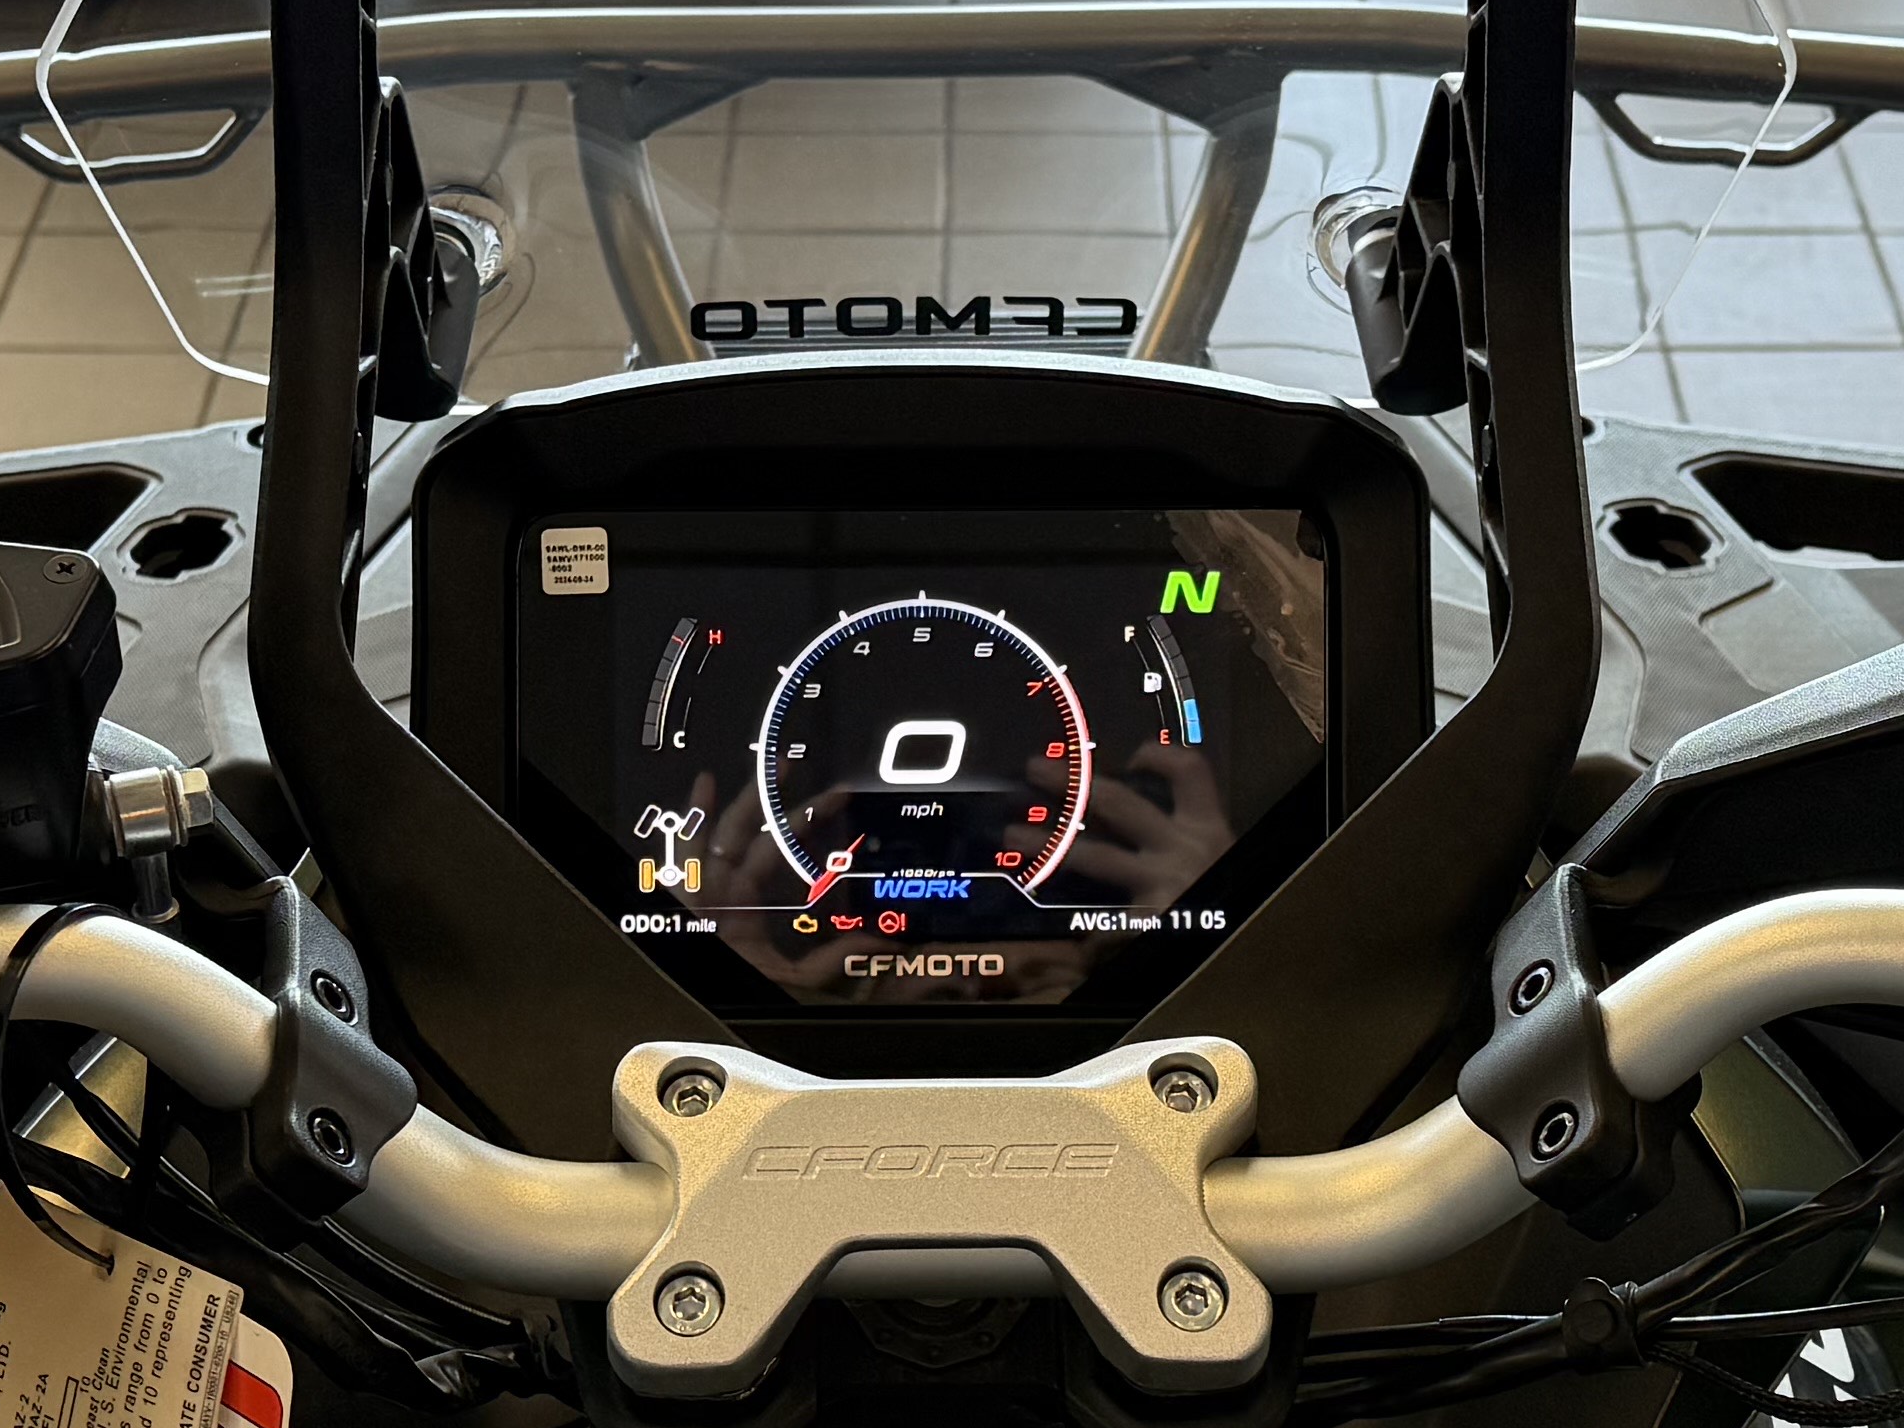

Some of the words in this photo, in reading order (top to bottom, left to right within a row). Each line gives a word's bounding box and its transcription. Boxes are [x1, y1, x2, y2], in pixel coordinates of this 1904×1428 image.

[1159, 571, 1221, 614] N
[709, 629, 721, 645] H
[912, 628, 932, 643] 5
[1124, 625, 1136, 643] F
[852, 641, 871, 656] 4
[974, 642, 994, 657] 6
[803, 683, 822, 698] 3
[1026, 681, 1044, 697] 7
[673, 730, 686, 749] C
[1160, 729, 1171, 745] E
[787, 743, 807, 759] 2
[879, 720, 967, 785] 0
[1046, 742, 1065, 758] 8
[804, 806, 815, 822] 1
[900, 802, 944, 819] mph
[1027, 806, 1048, 822] 9
[825, 850, 853, 872] 0
[994, 851, 1024, 867] 10
[874, 879, 972, 899] WORK
[620, 914, 681, 934] ODO:1
[686, 916, 717, 934] mile
[844, 954, 1005, 978] CFMOTO
[743, 1143, 1120, 1180] CFORCE
